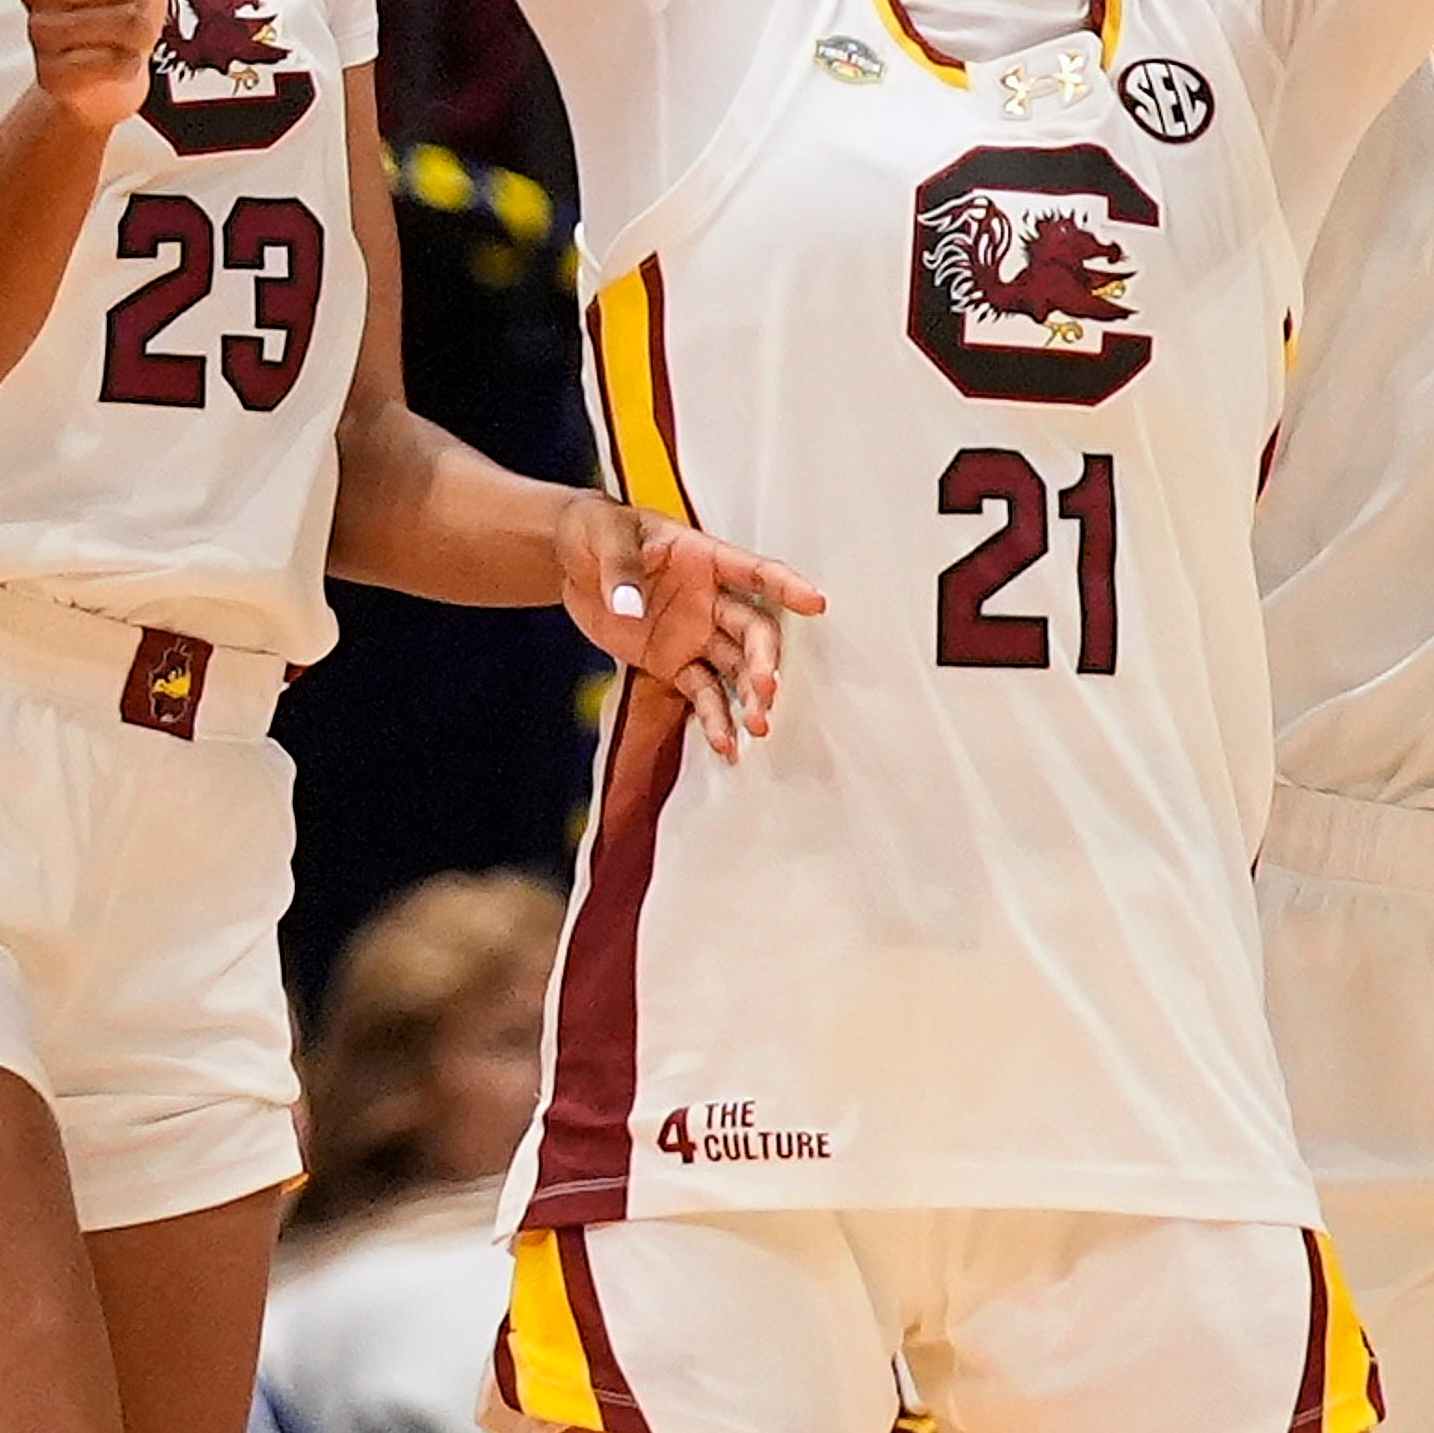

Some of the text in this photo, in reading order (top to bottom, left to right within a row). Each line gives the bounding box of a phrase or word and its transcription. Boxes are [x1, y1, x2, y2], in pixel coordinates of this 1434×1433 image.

[1125, 63, 1208, 137] SEC
[98, 193, 324, 412] 23
[936, 447, 1117, 676] 21
[657, 1106, 696, 1164] 4
[704, 1131, 832, 1163] CULTURE
[705, 1101, 756, 1129] THE
